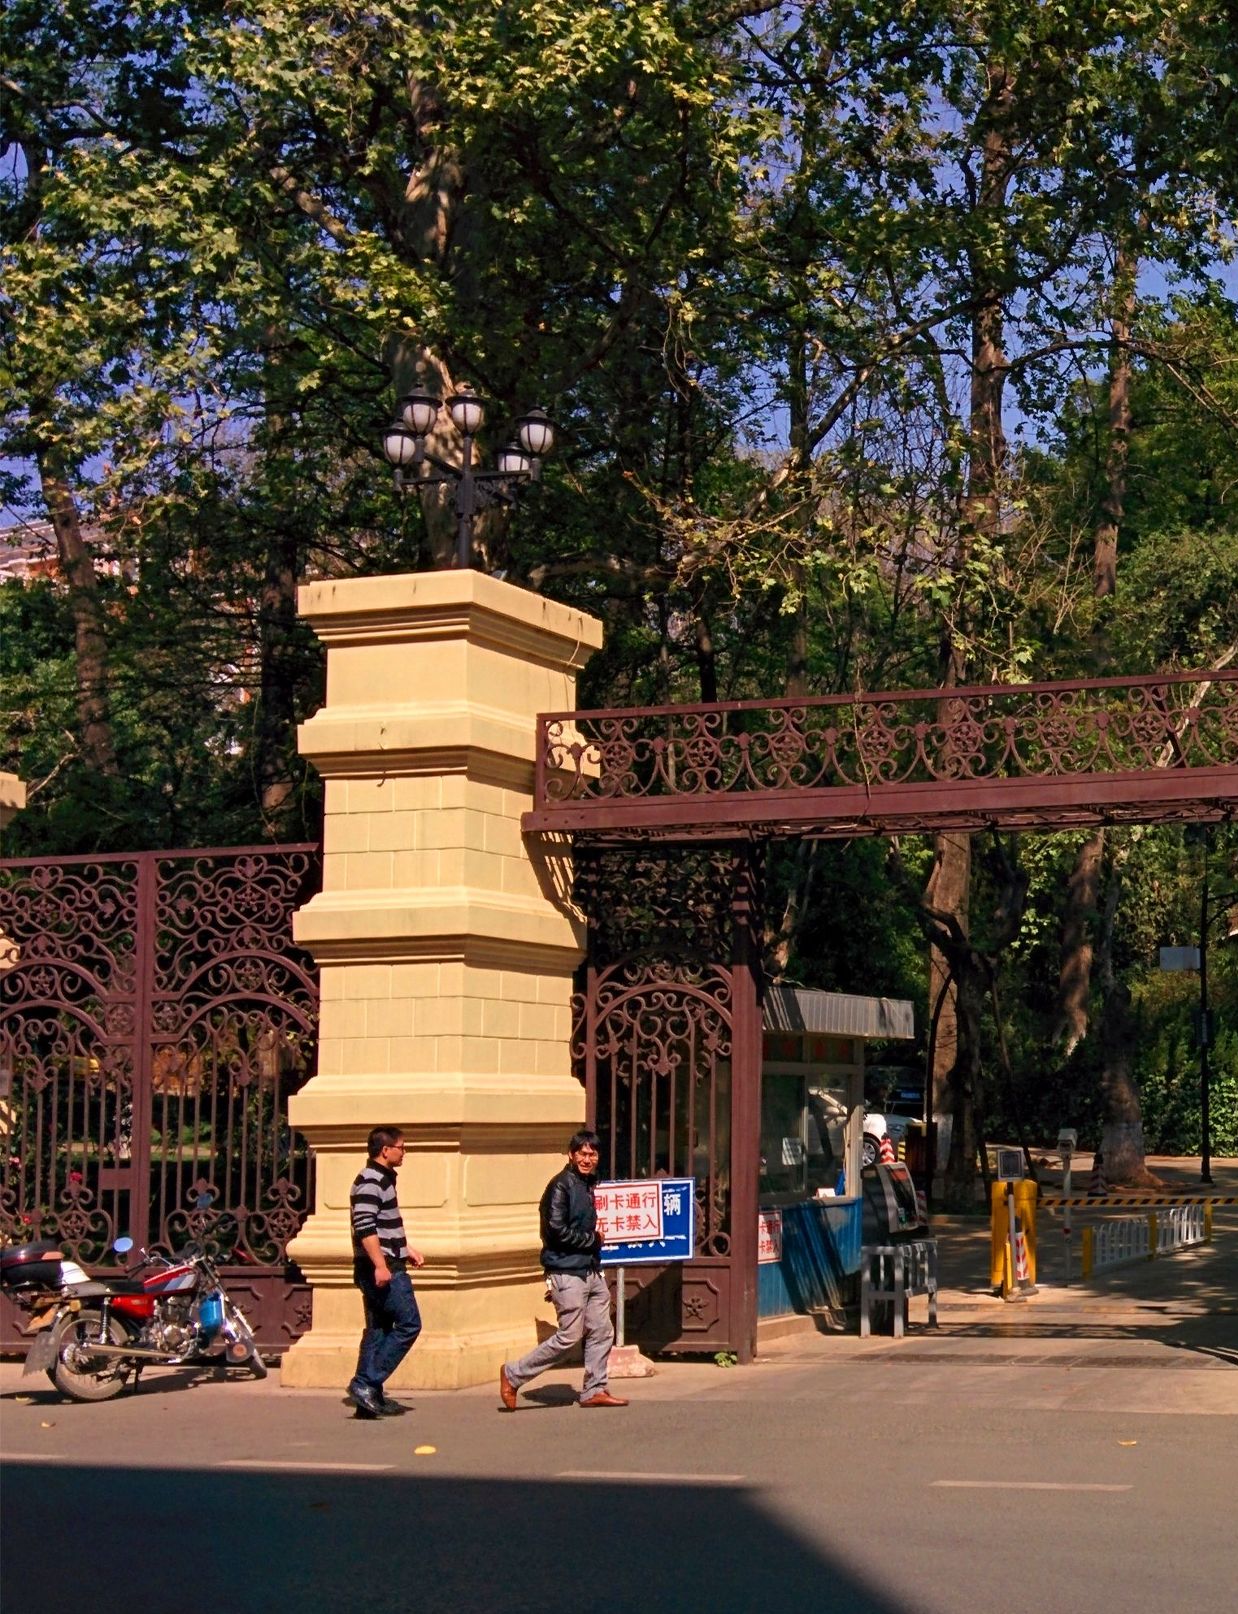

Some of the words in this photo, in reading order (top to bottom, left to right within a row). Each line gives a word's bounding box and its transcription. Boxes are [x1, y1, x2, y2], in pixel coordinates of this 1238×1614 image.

[594, 1192, 656, 1211] 刷卡通行
[663, 1193, 681, 1216] 辆
[597, 1213, 657, 1233] 无卡禁入
